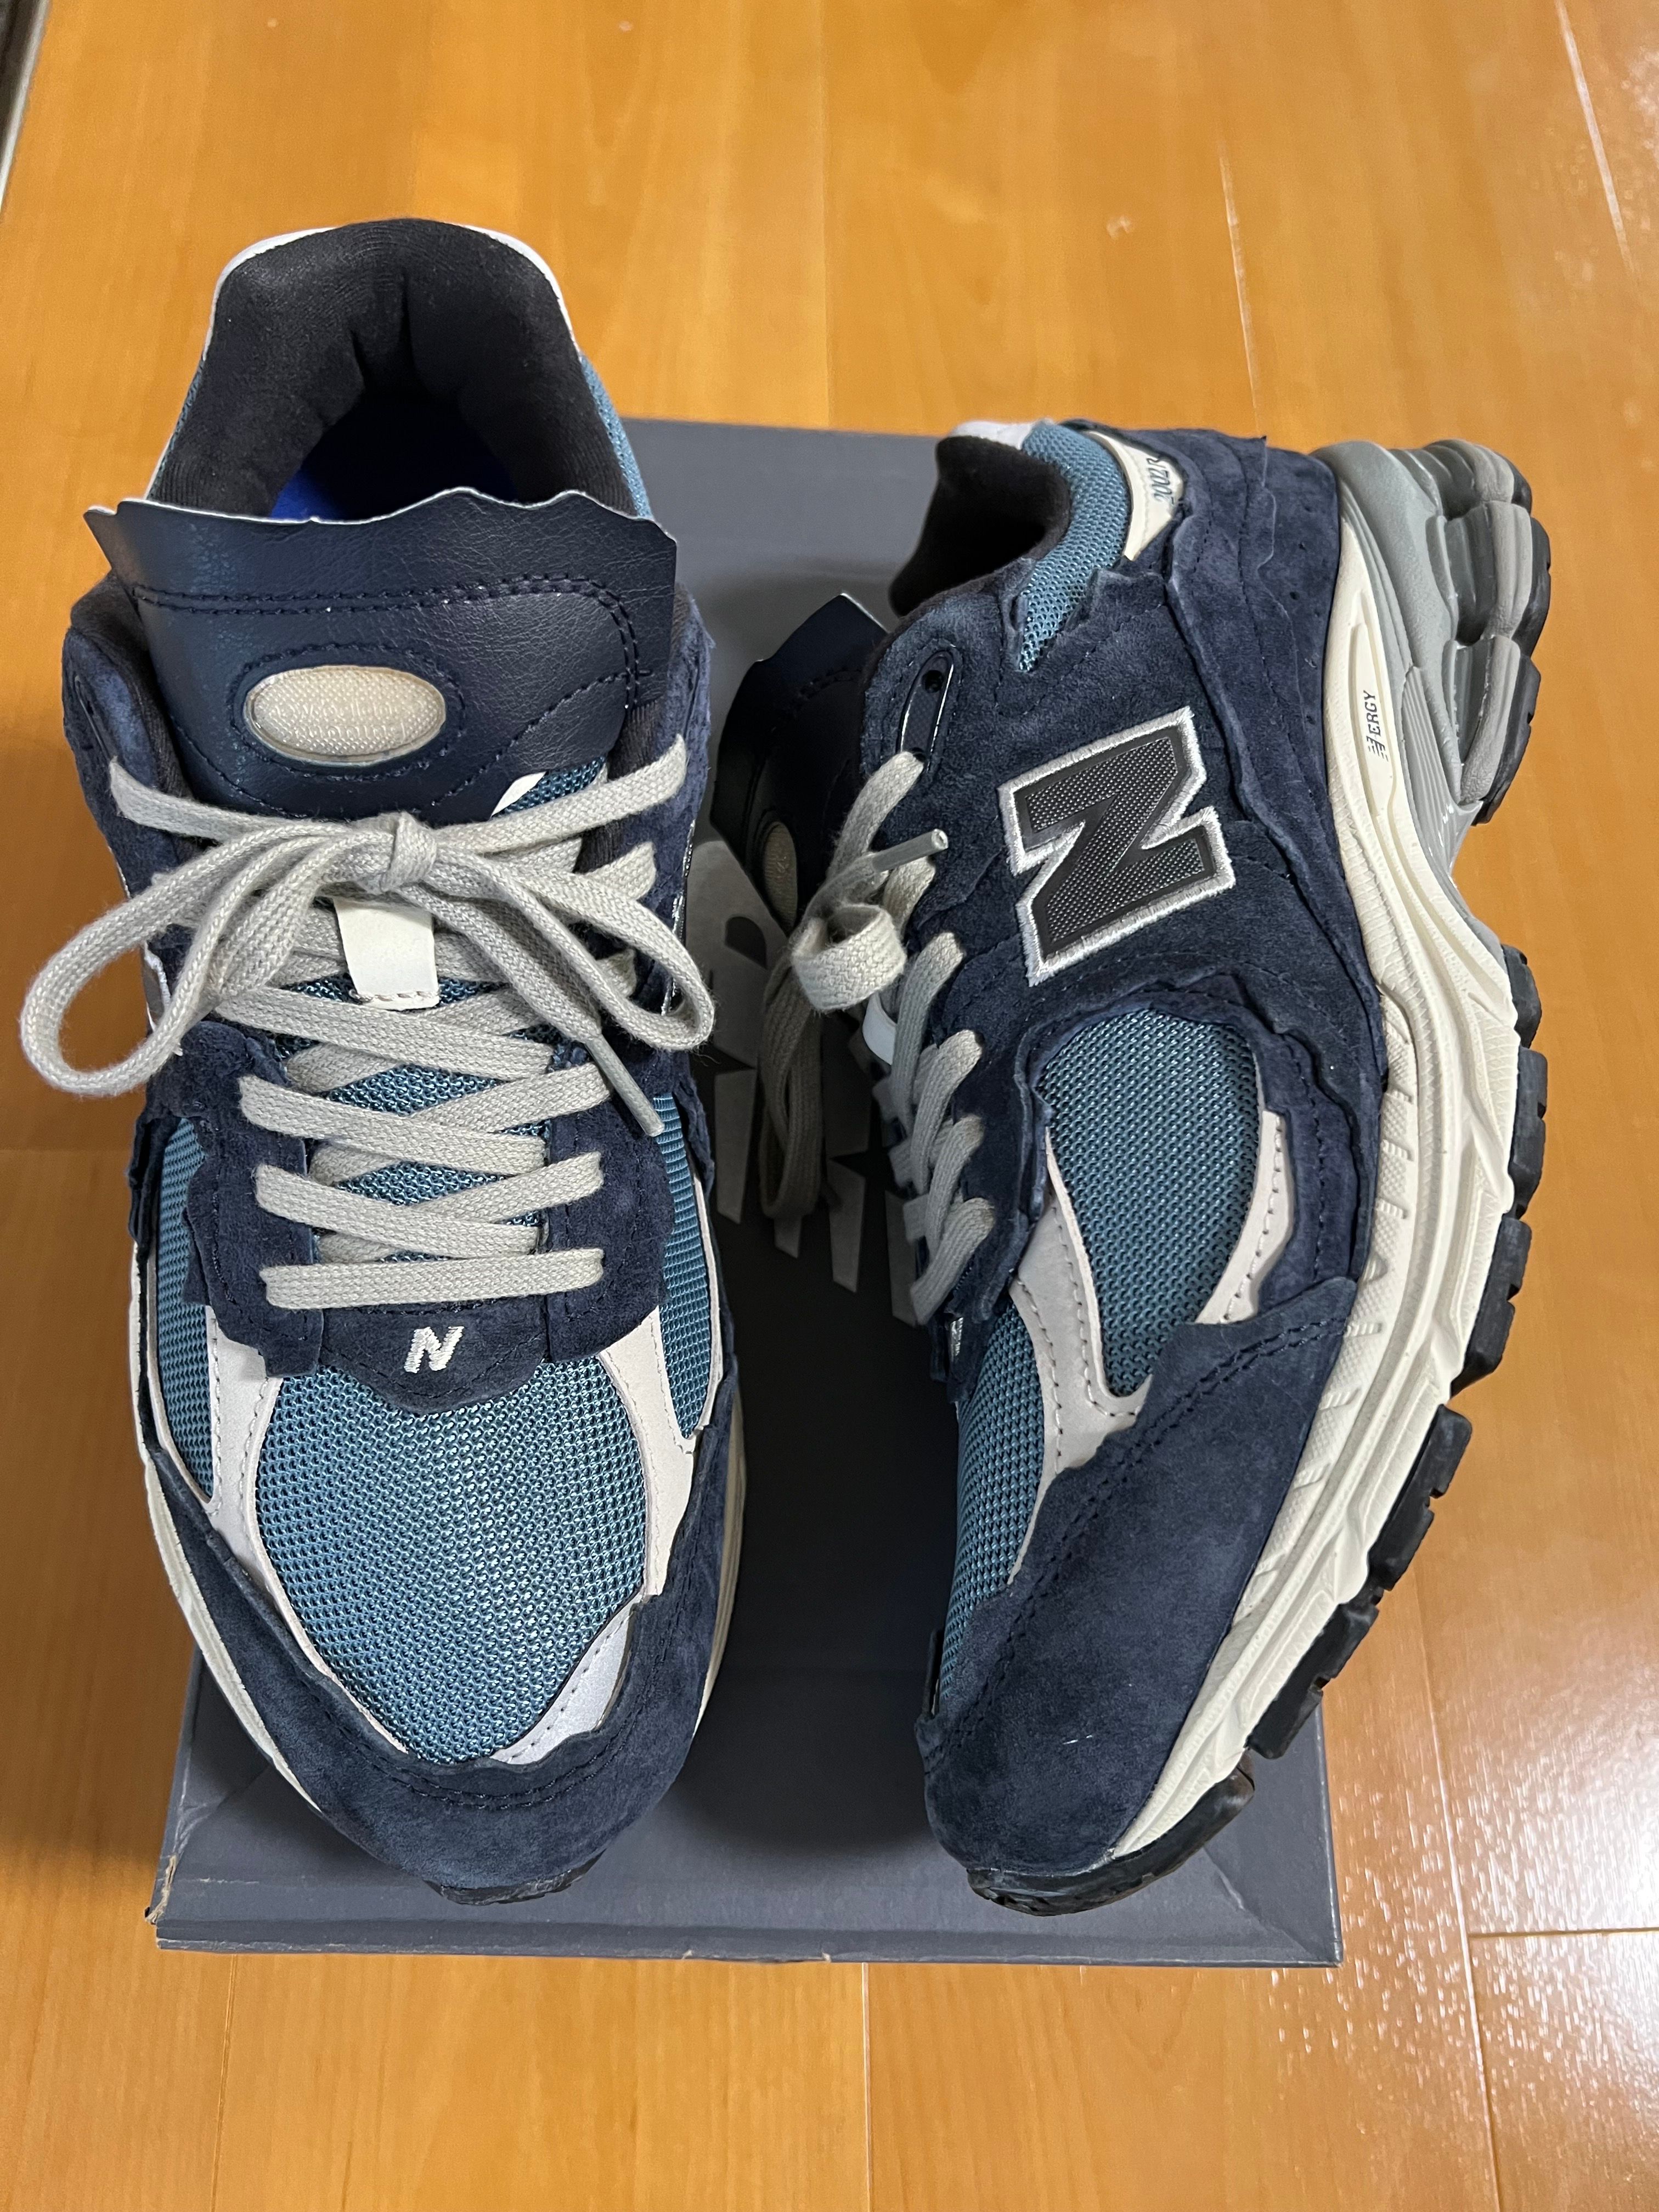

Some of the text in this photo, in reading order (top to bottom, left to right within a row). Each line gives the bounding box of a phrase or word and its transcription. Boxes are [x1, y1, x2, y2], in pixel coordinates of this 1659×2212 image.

[1146, 458, 1174, 505] 2002R
[997, 706, 1236, 987] N
[404, 1326, 465, 1373] N
